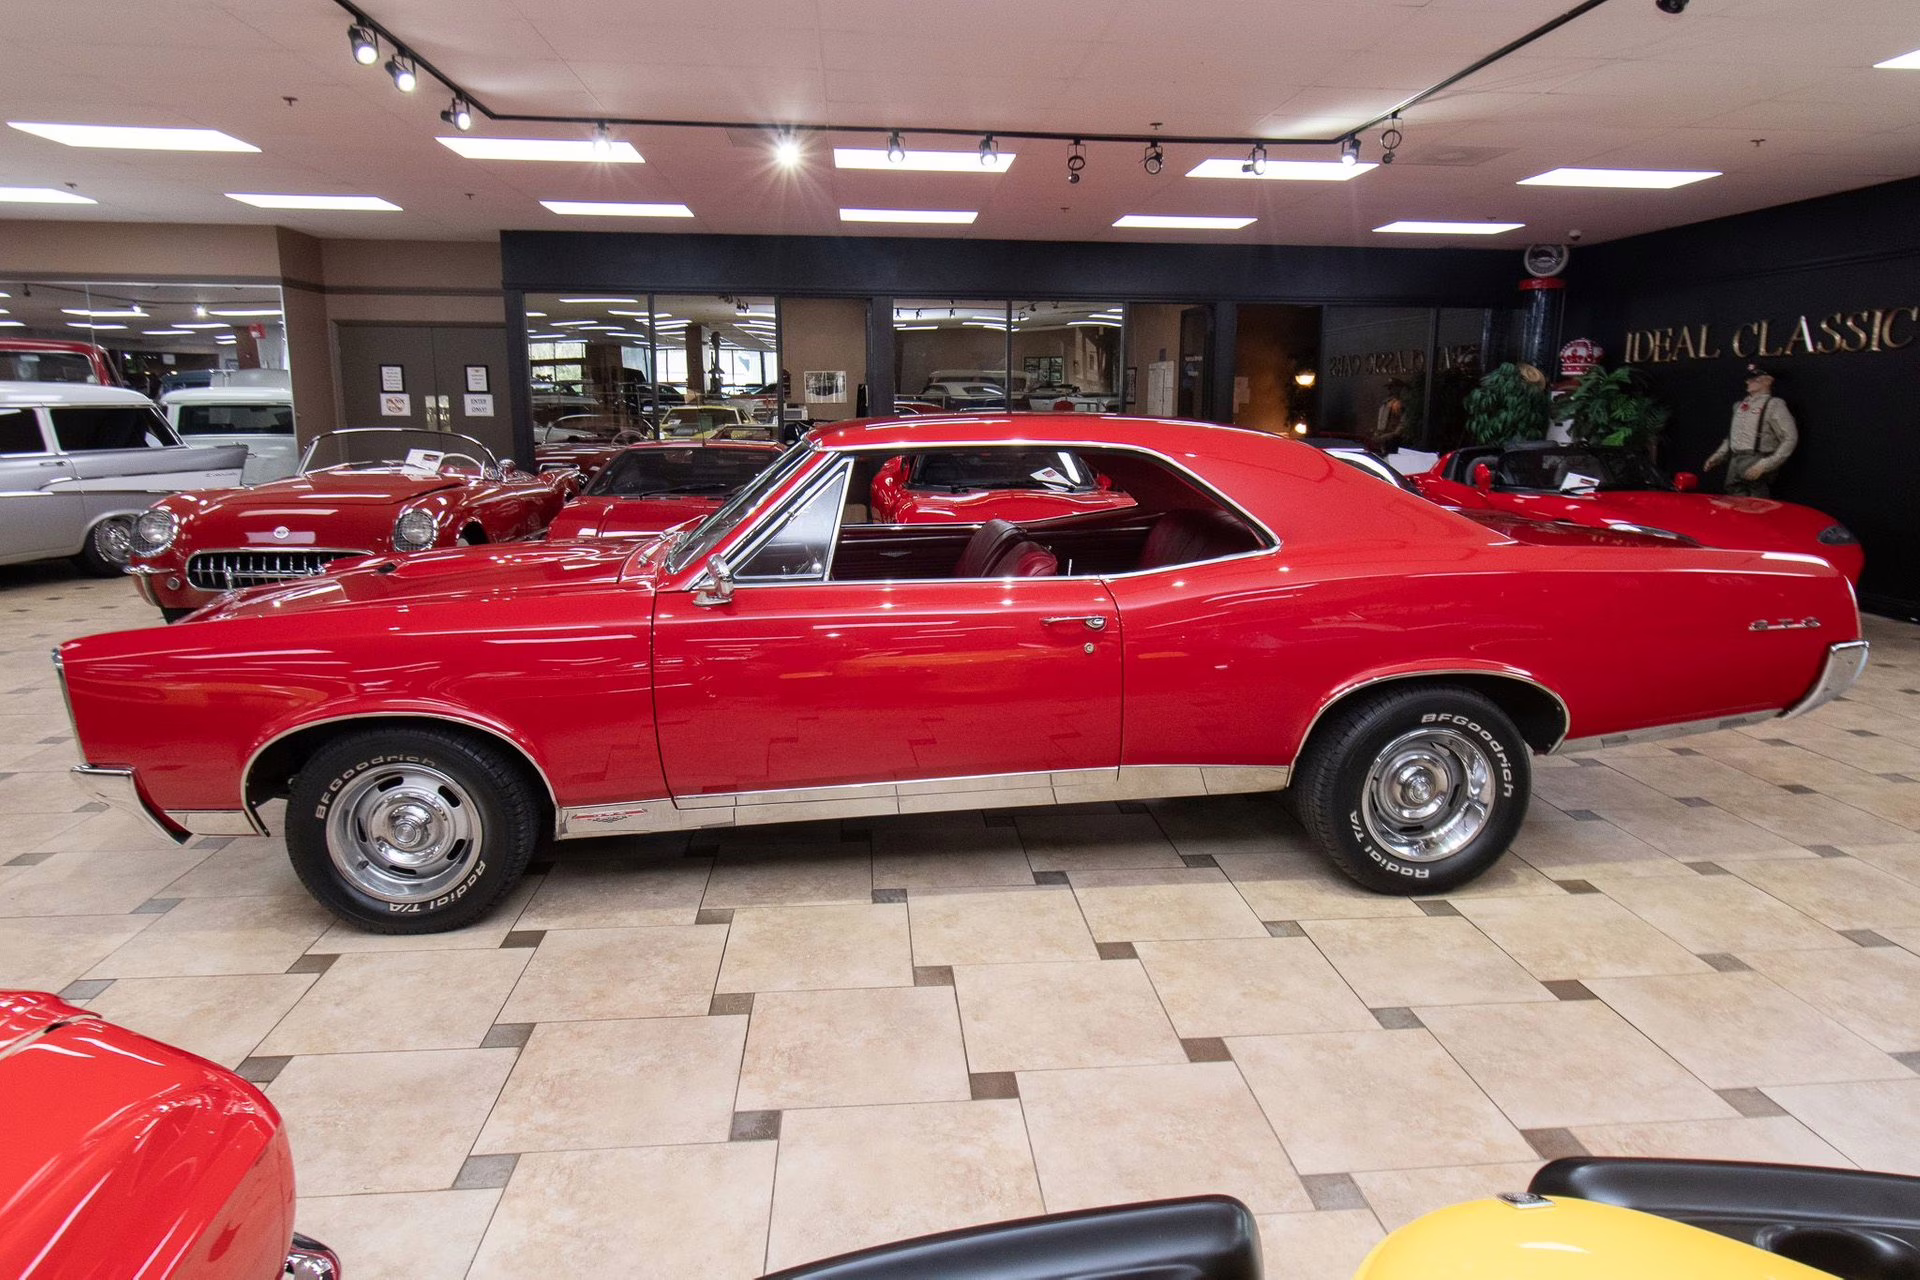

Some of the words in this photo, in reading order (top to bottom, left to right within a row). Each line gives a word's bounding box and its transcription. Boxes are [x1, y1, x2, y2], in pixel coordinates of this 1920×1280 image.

[1624, 322, 1720, 364] IDEAL
[1732, 306, 1919, 358] CLASSIC
[1748, 617, 1821, 630] GTO
[1421, 713, 1514, 798] BFGoodrich
[315, 754, 437, 819] BFGoodrich
[1350, 810, 1362, 842] T/A
[1364, 845, 1430, 879] Radial
[429, 860, 486, 912] Radial
[389, 903, 421, 913] T/A
